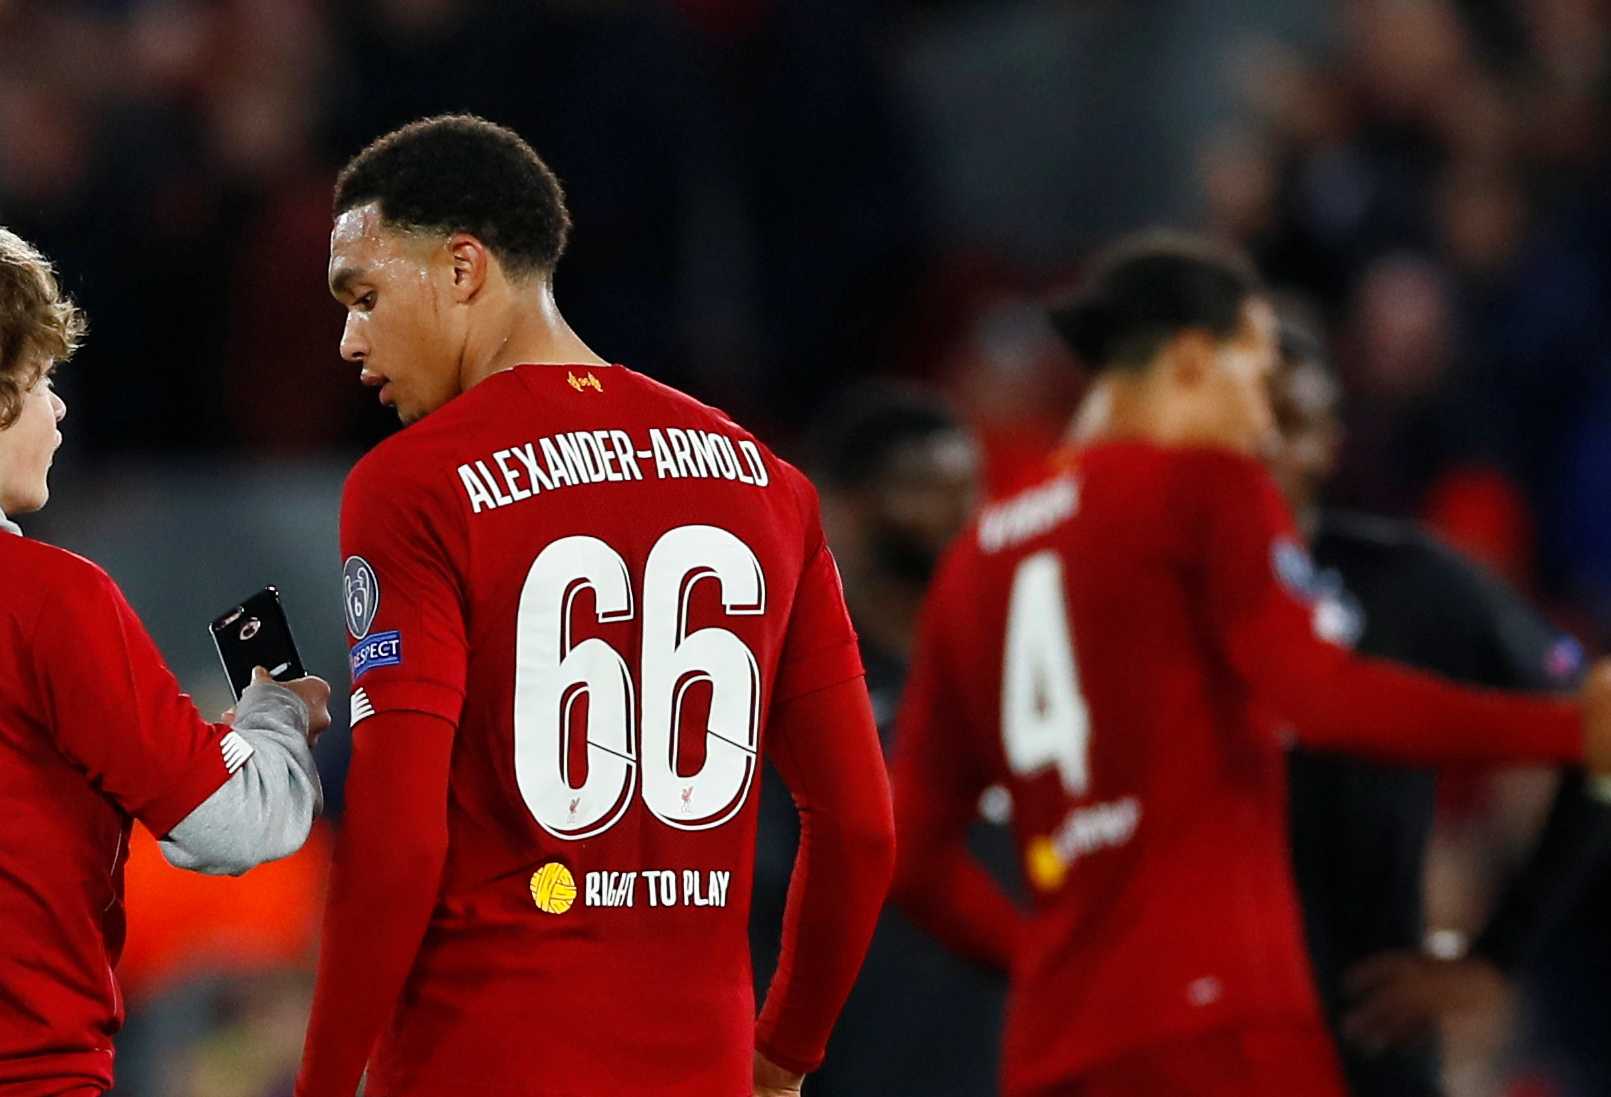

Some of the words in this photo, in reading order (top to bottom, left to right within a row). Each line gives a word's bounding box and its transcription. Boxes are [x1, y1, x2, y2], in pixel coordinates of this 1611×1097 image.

[457, 427, 770, 513] ALEXANDER-ARNOLD
[353, 639, 400, 668] ESPECT
[513, 523, 766, 841] 66
[1001, 550, 1091, 797] 4
[585, 870, 638, 908] RIGHT
[641, 869, 677, 907] TO
[682, 869, 731, 908] PLAY
